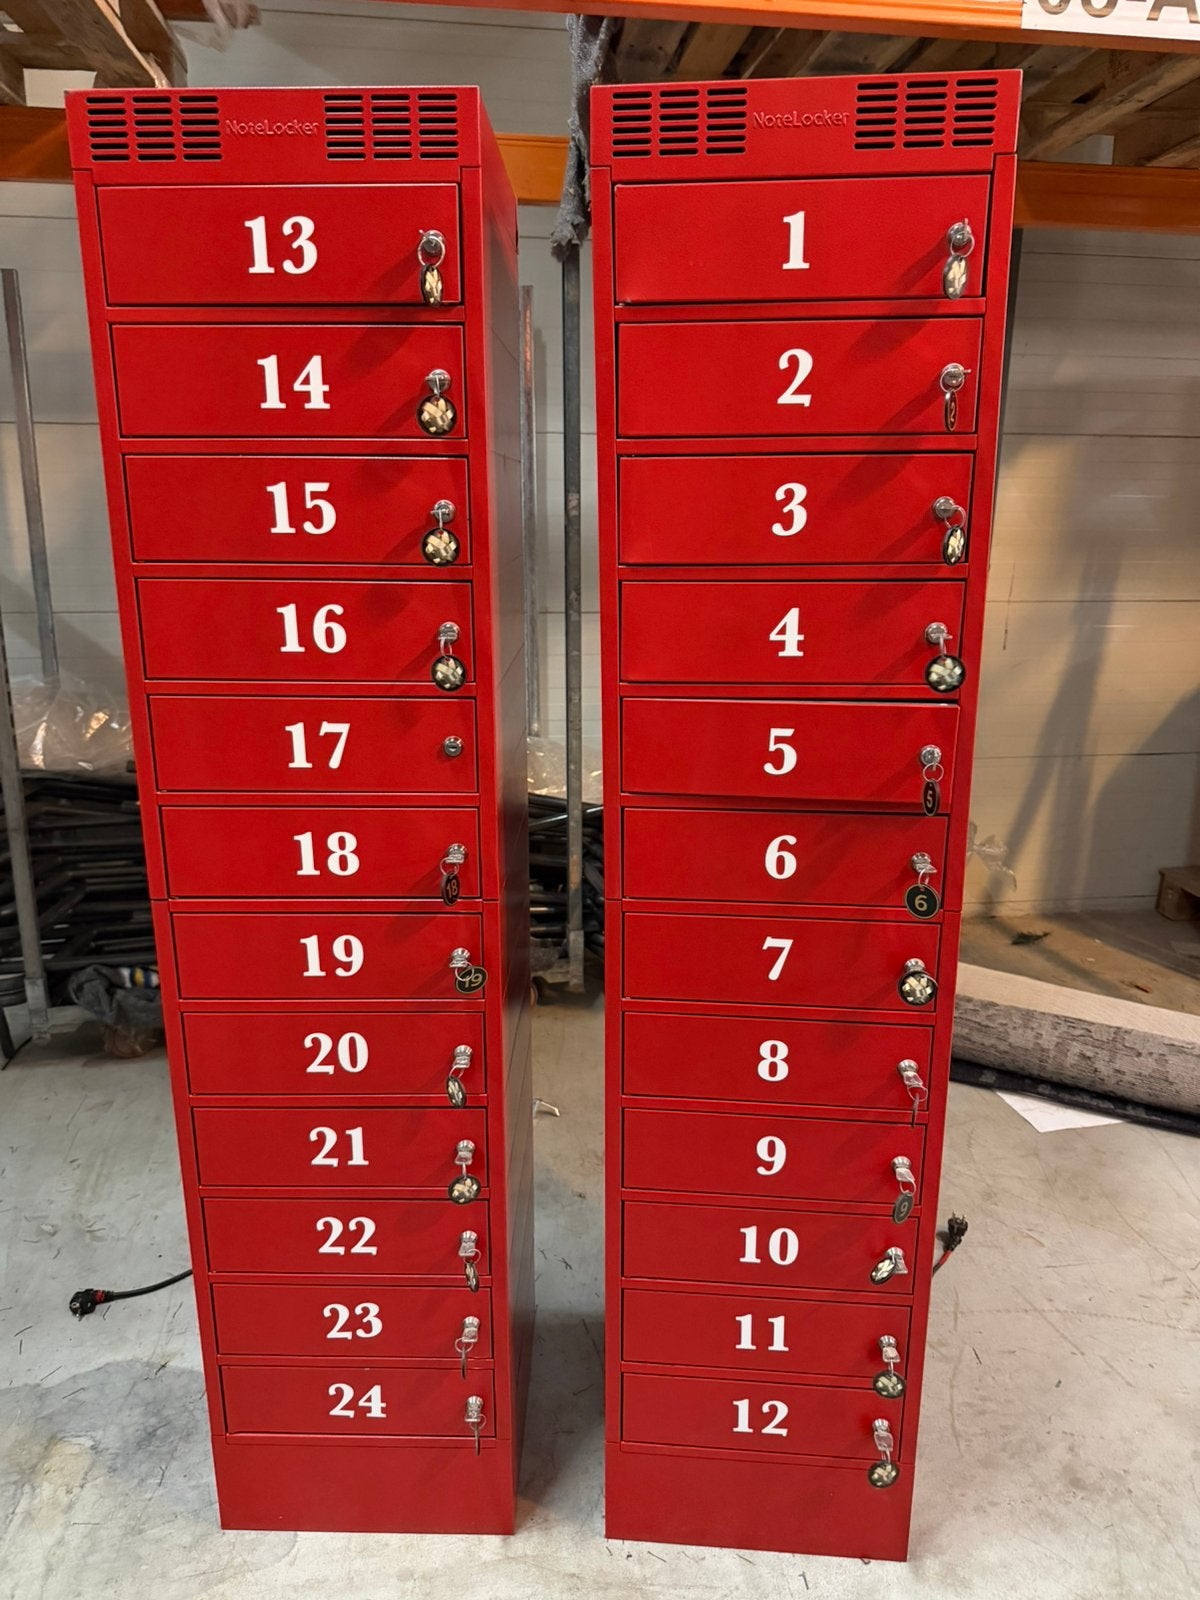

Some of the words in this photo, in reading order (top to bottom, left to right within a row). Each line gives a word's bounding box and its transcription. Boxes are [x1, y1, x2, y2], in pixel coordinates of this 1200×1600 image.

[225, 119, 319, 136] NoteLocker
[753, 109, 850, 128] NoteLocker
[245, 216, 317, 274] 13
[783, 212, 809, 269] 1
[257, 355, 331, 409] 14
[777, 348, 813, 406] 2
[266, 482, 337, 535] 15
[771, 482, 808, 537] 3
[276, 603, 348, 654] 16
[769, 607, 805, 657] 4
[285, 722, 351, 769] 17
[763, 727, 797, 775] 5
[926, 790, 934, 808] 5
[293, 831, 360, 876] 18
[765, 834, 797, 880] 6
[446, 879, 459, 899] 18
[914, 894, 928, 911] 6
[300, 935, 364, 977] 19
[763, 937, 794, 981] 7
[463, 973, 483, 989] 19
[304, 1032, 369, 1075] 20
[757, 1039, 789, 1082] 8
[309, 1126, 369, 1168] 21
[756, 1135, 787, 1176] 9
[899, 1201, 909, 1218] 9
[316, 1216, 378, 1256] 22
[739, 1225, 799, 1266] 10
[323, 1302, 383, 1340] 23
[735, 1313, 789, 1352] 11
[328, 1383, 387, 1419] 24
[733, 1398, 789, 1437] 12
